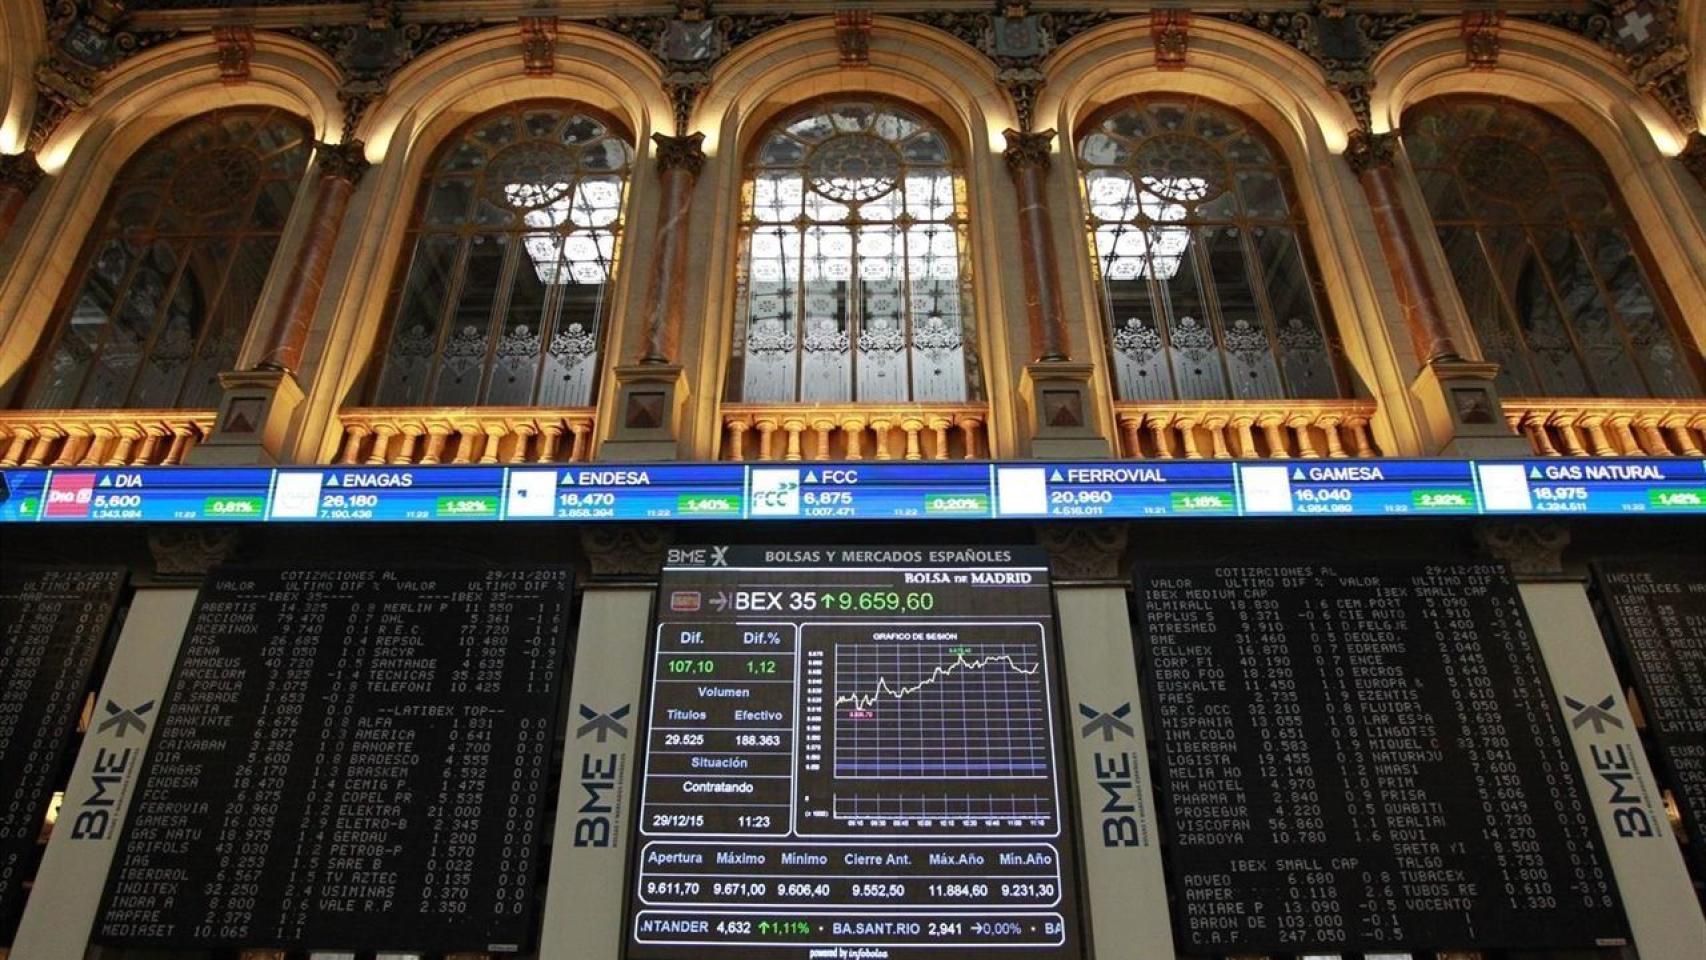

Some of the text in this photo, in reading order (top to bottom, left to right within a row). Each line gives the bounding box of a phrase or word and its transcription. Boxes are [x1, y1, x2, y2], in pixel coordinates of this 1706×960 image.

[578, 472, 650, 485] ENDESA
[822, 471, 858, 484] FCC
[1068, 469, 1166, 482] FERROVIAL
[1310, 468, 1384, 480] GAMESA
[1546, 466, 1665, 480] GAS NATURAL
[116, 475, 143, 488] DIA
[344, 474, 412, 487] ENAGAS
[560, 494, 615, 506] 18,470
[753, 491, 788, 507] FCC
[804, 492, 852, 505] 6,875
[1051, 491, 1112, 504] 20,960
[1295, 490, 1351, 502] 16,040
[1532, 488, 1588, 500] 18,975
[94, 495, 141, 508] 5,600
[322, 495, 378, 508] 26,180
[668, 550, 706, 563] BME
[766, 548, 1012, 562] BOLSAS Y MERCADOS ESPAÑOLES
[280, 571, 398, 581] COTIZACIONES AL
[904, 572, 950, 584] BOLSA
[971, 572, 1032, 584] MADRID
[1215, 568, 1313, 578] COTIZACIONES
[216, 581, 333, 591] VALOR ULTIMO
[1152, 578, 1274, 588] VALOR ULTIMO
[1146, 590, 1178, 600] IBEX
[789, 591, 817, 610] 35
[838, 592, 934, 613] 9.659,60
[376, 636, 424, 646] REPSOL
[680, 632, 781, 644] Dif. Dif.%
[912, 632, 924, 640] DE
[1151, 634, 1176, 644] BME
[668, 660, 776, 674] 107,10 1,12
[366, 682, 432, 692] TELEFONI
[698, 686, 750, 697] Volumen
[734, 710, 783, 721] Efectivo
[1162, 717, 1234, 728] HISPANIA
[162, 728, 196, 738] BBVA
[354, 730, 415, 740] AMERICA
[664, 734, 780, 746] 29.525 188.363
[350, 754, 420, 765] BRADESCO
[692, 756, 748, 768] Situación
[1168, 754, 1231, 766] LOGISTA
[347, 767, 409, 778] BRASKEM
[1169, 768, 1214, 778] MELIA
[683, 780, 754, 793] Contratando
[1590, 744, 1654, 838] BME
[70, 748, 131, 840] BME
[1094, 751, 1139, 848] BME
[1381, 790, 1427, 800] PRISA
[574, 753, 618, 848] BME
[339, 804, 401, 816] ELEKTRA
[1175, 806, 1248, 818] PROSEGUR
[652, 815, 771, 828] 29/12/15 11:23
[1176, 820, 1250, 831] VISCOFAN
[333, 832, 388, 842] GERDAU
[1178, 833, 1244, 845] ZARDOYA
[648, 852, 702, 864] Apertura
[716, 852, 766, 864] Máximo
[844, 853, 882, 865] Cierre
[886, 853, 912, 865] Ant.
[928, 852, 984, 865] Máx.Año
[999, 852, 1052, 865] Mín.Año
[1231, 858, 1359, 872] IBEX SMALL CAP
[1400, 870, 1464, 882] TUBACEX
[116, 883, 178, 894] INDITEX
[321, 886, 396, 898] USIMINAS
[647, 882, 1054, 898] 9.611,70 9.671,00 9.606,40 9.552,50 11.884,60 9.231,30
[319, 900, 355, 912] VALE
[1406, 900, 1472, 911] VOCENTO
[106, 910, 160, 922] MAPFRE
[1190, 916, 1238, 928] BARON
[1248, 916, 1266, 928] DE
[102, 925, 176, 936] MEDIASET
[716, 921, 752, 935] 4,632
[772, 922, 810, 935] 1,11%
[832, 922, 920, 936] BA.SANT.RIO
[928, 923, 962, 937] 2,941
[983, 924, 1022, 937] 0,00%
[810, 947, 838, 959] powered
[840, 947, 848, 959] by
